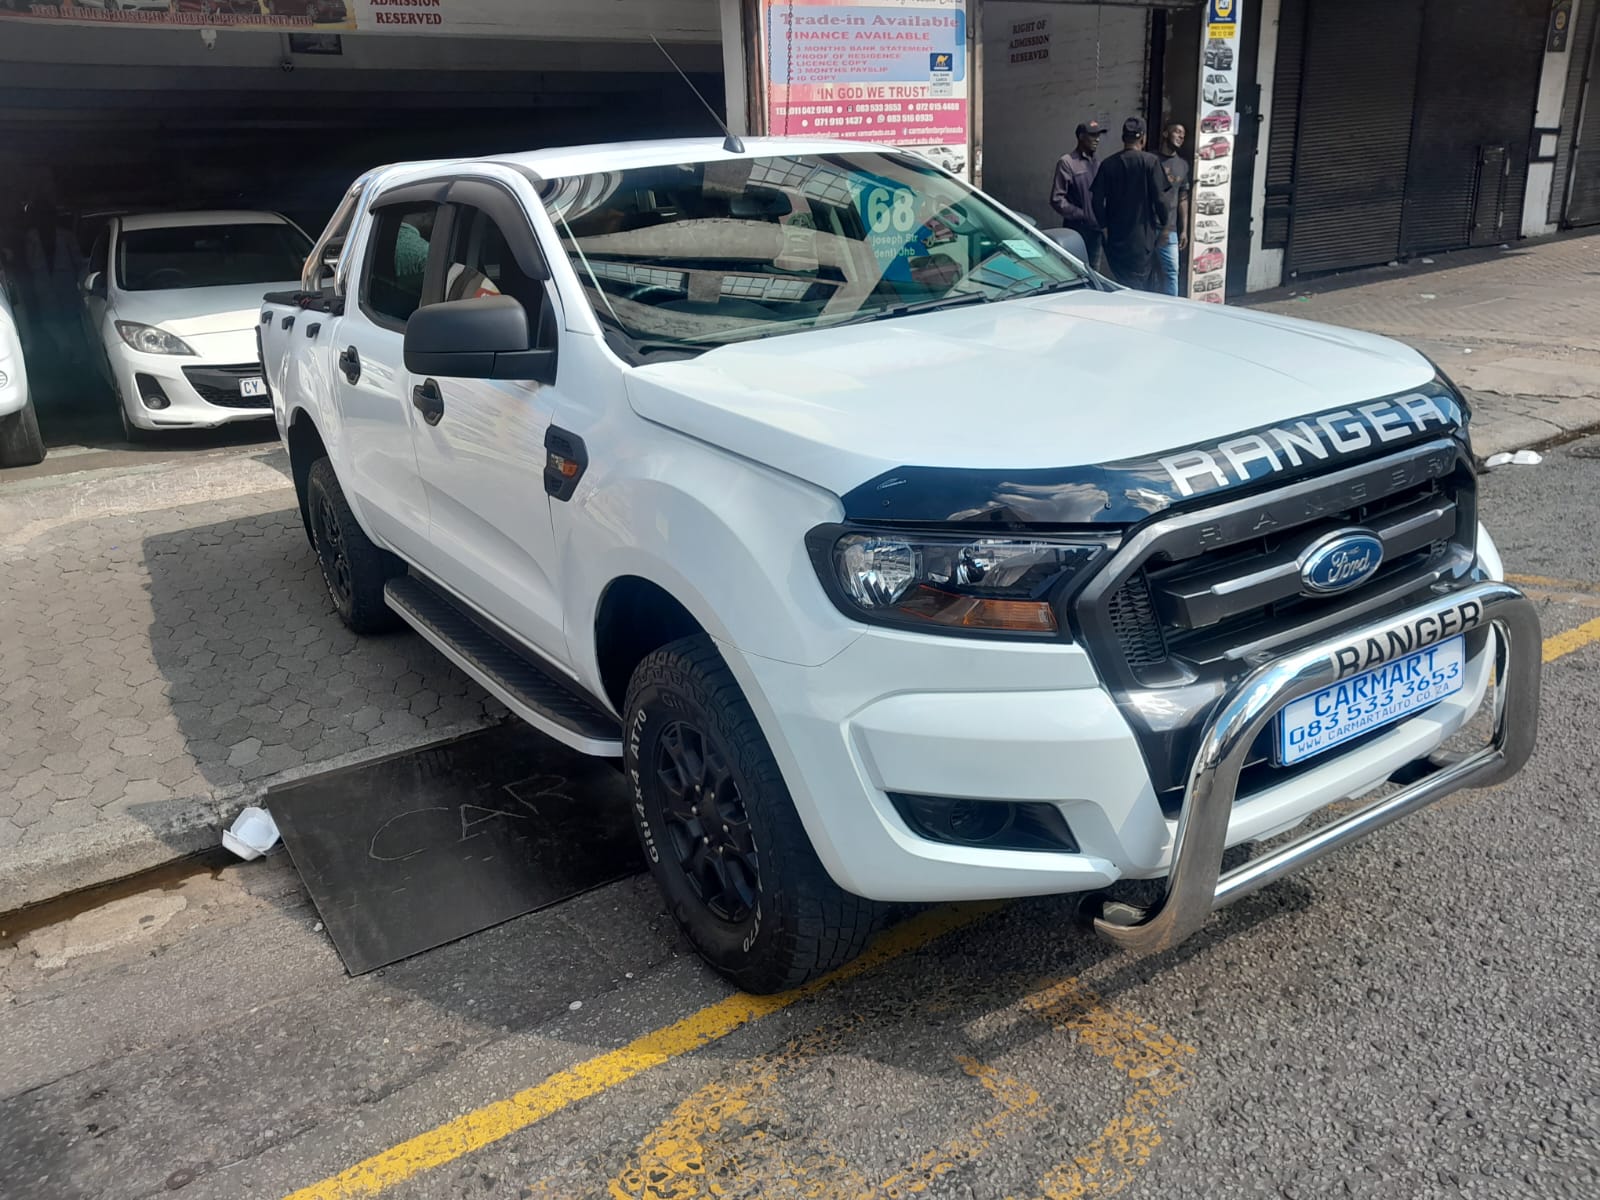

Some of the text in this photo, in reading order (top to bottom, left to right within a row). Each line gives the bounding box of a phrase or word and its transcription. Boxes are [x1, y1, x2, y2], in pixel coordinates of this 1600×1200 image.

[375, 12, 443, 25] RESERVED
[780, 13, 960, 28] Trade-in Available
[1013, 19, 1047, 34] RIGHT OF
[786, 31, 930, 41] FINANCE AVAILABLE
[838, 87, 863, 99] GOD
[867, 87, 886, 98] WE
[243, 380, 258, 394] CY
[1158, 392, 1449, 497] RANGER
[1327, 546, 1370, 583] Ford
[1334, 600, 1480, 681] RANGER
[1314, 648, 1439, 718] CARMART
[1289, 661, 1460, 747] 083 533 3653
[630, 708, 648, 760] AT70
